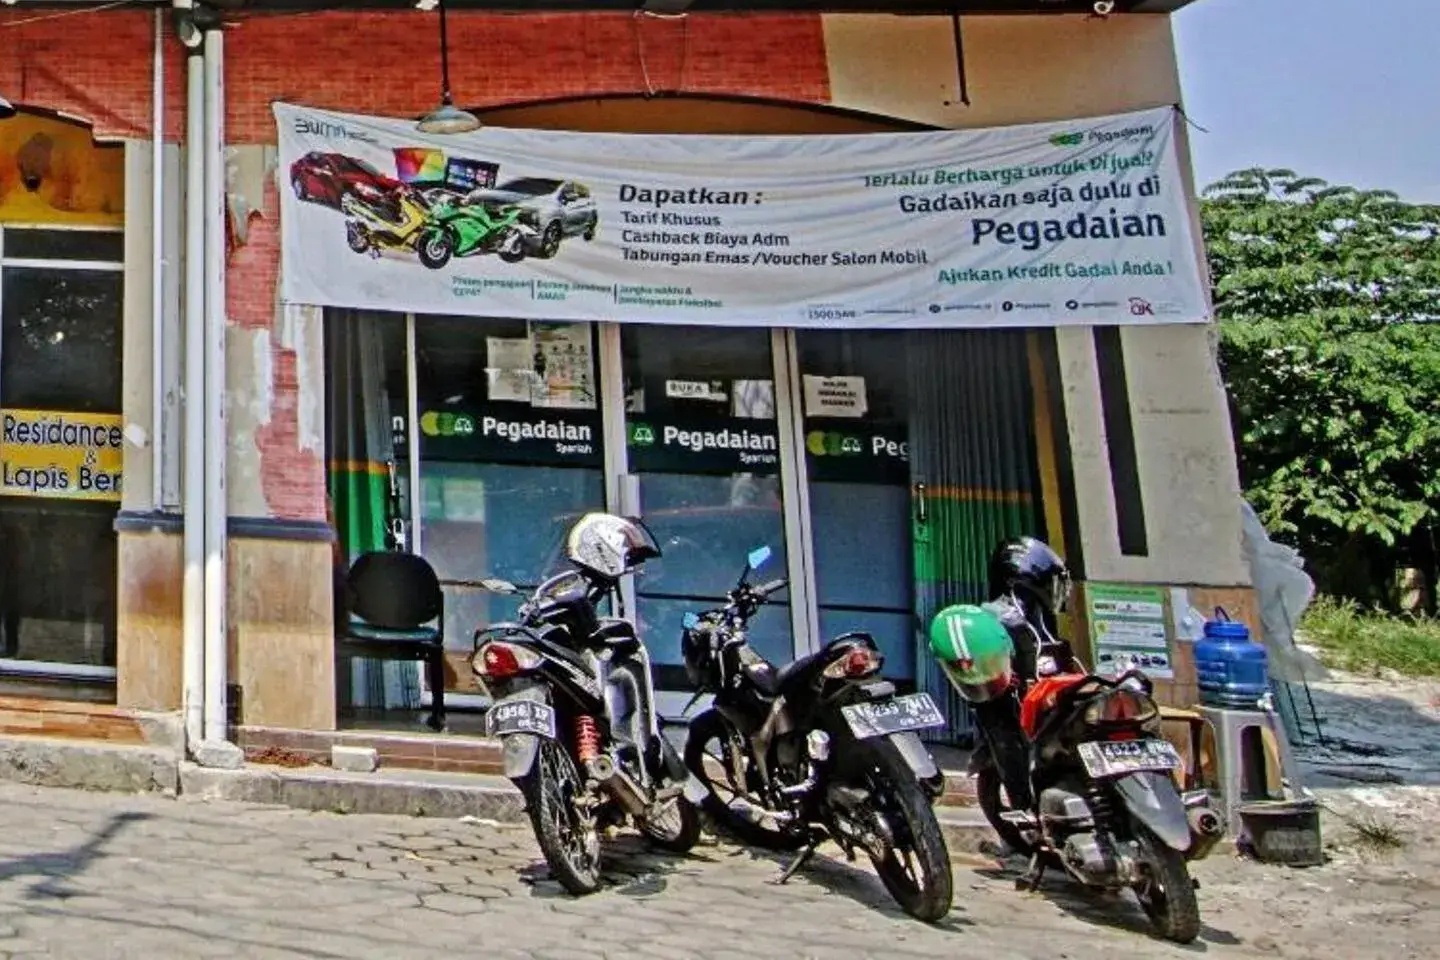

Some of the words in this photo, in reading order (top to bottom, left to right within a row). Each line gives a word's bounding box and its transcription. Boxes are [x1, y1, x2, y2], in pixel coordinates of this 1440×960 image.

[934, 167, 1023, 187] Berharga
[619, 184, 747, 208] Dapatkan
[899, 189, 1018, 213] Gadaikan
[1023, 183, 1072, 208] saja
[1079, 179, 1131, 202] dulu
[1139, 175, 1160, 198] di
[621, 211, 658, 224] Tarif
[661, 212, 721, 227] Khusus
[972, 208, 1166, 250] Pegadaian
[622, 230, 700, 245] Cashback
[704, 232, 748, 248] Biaya
[752, 232, 790, 247] Adm
[621, 247, 701, 266] Tabungan
[705, 251, 749, 265] Emas
[832, 250, 877, 265] Salon
[881, 249, 929, 265] Mobil
[938, 267, 1004, 286] Ajukan
[1007, 263, 1062, 280] Kredit
[1065, 261, 1117, 278] Gadai
[1122, 260, 1165, 276] Anda
[4, 414, 122, 447] Residance
[482, 416, 592, 442] Pegadaian
[663, 426, 777, 451] Pegadaian
[3, 461, 69, 491] Lapis
